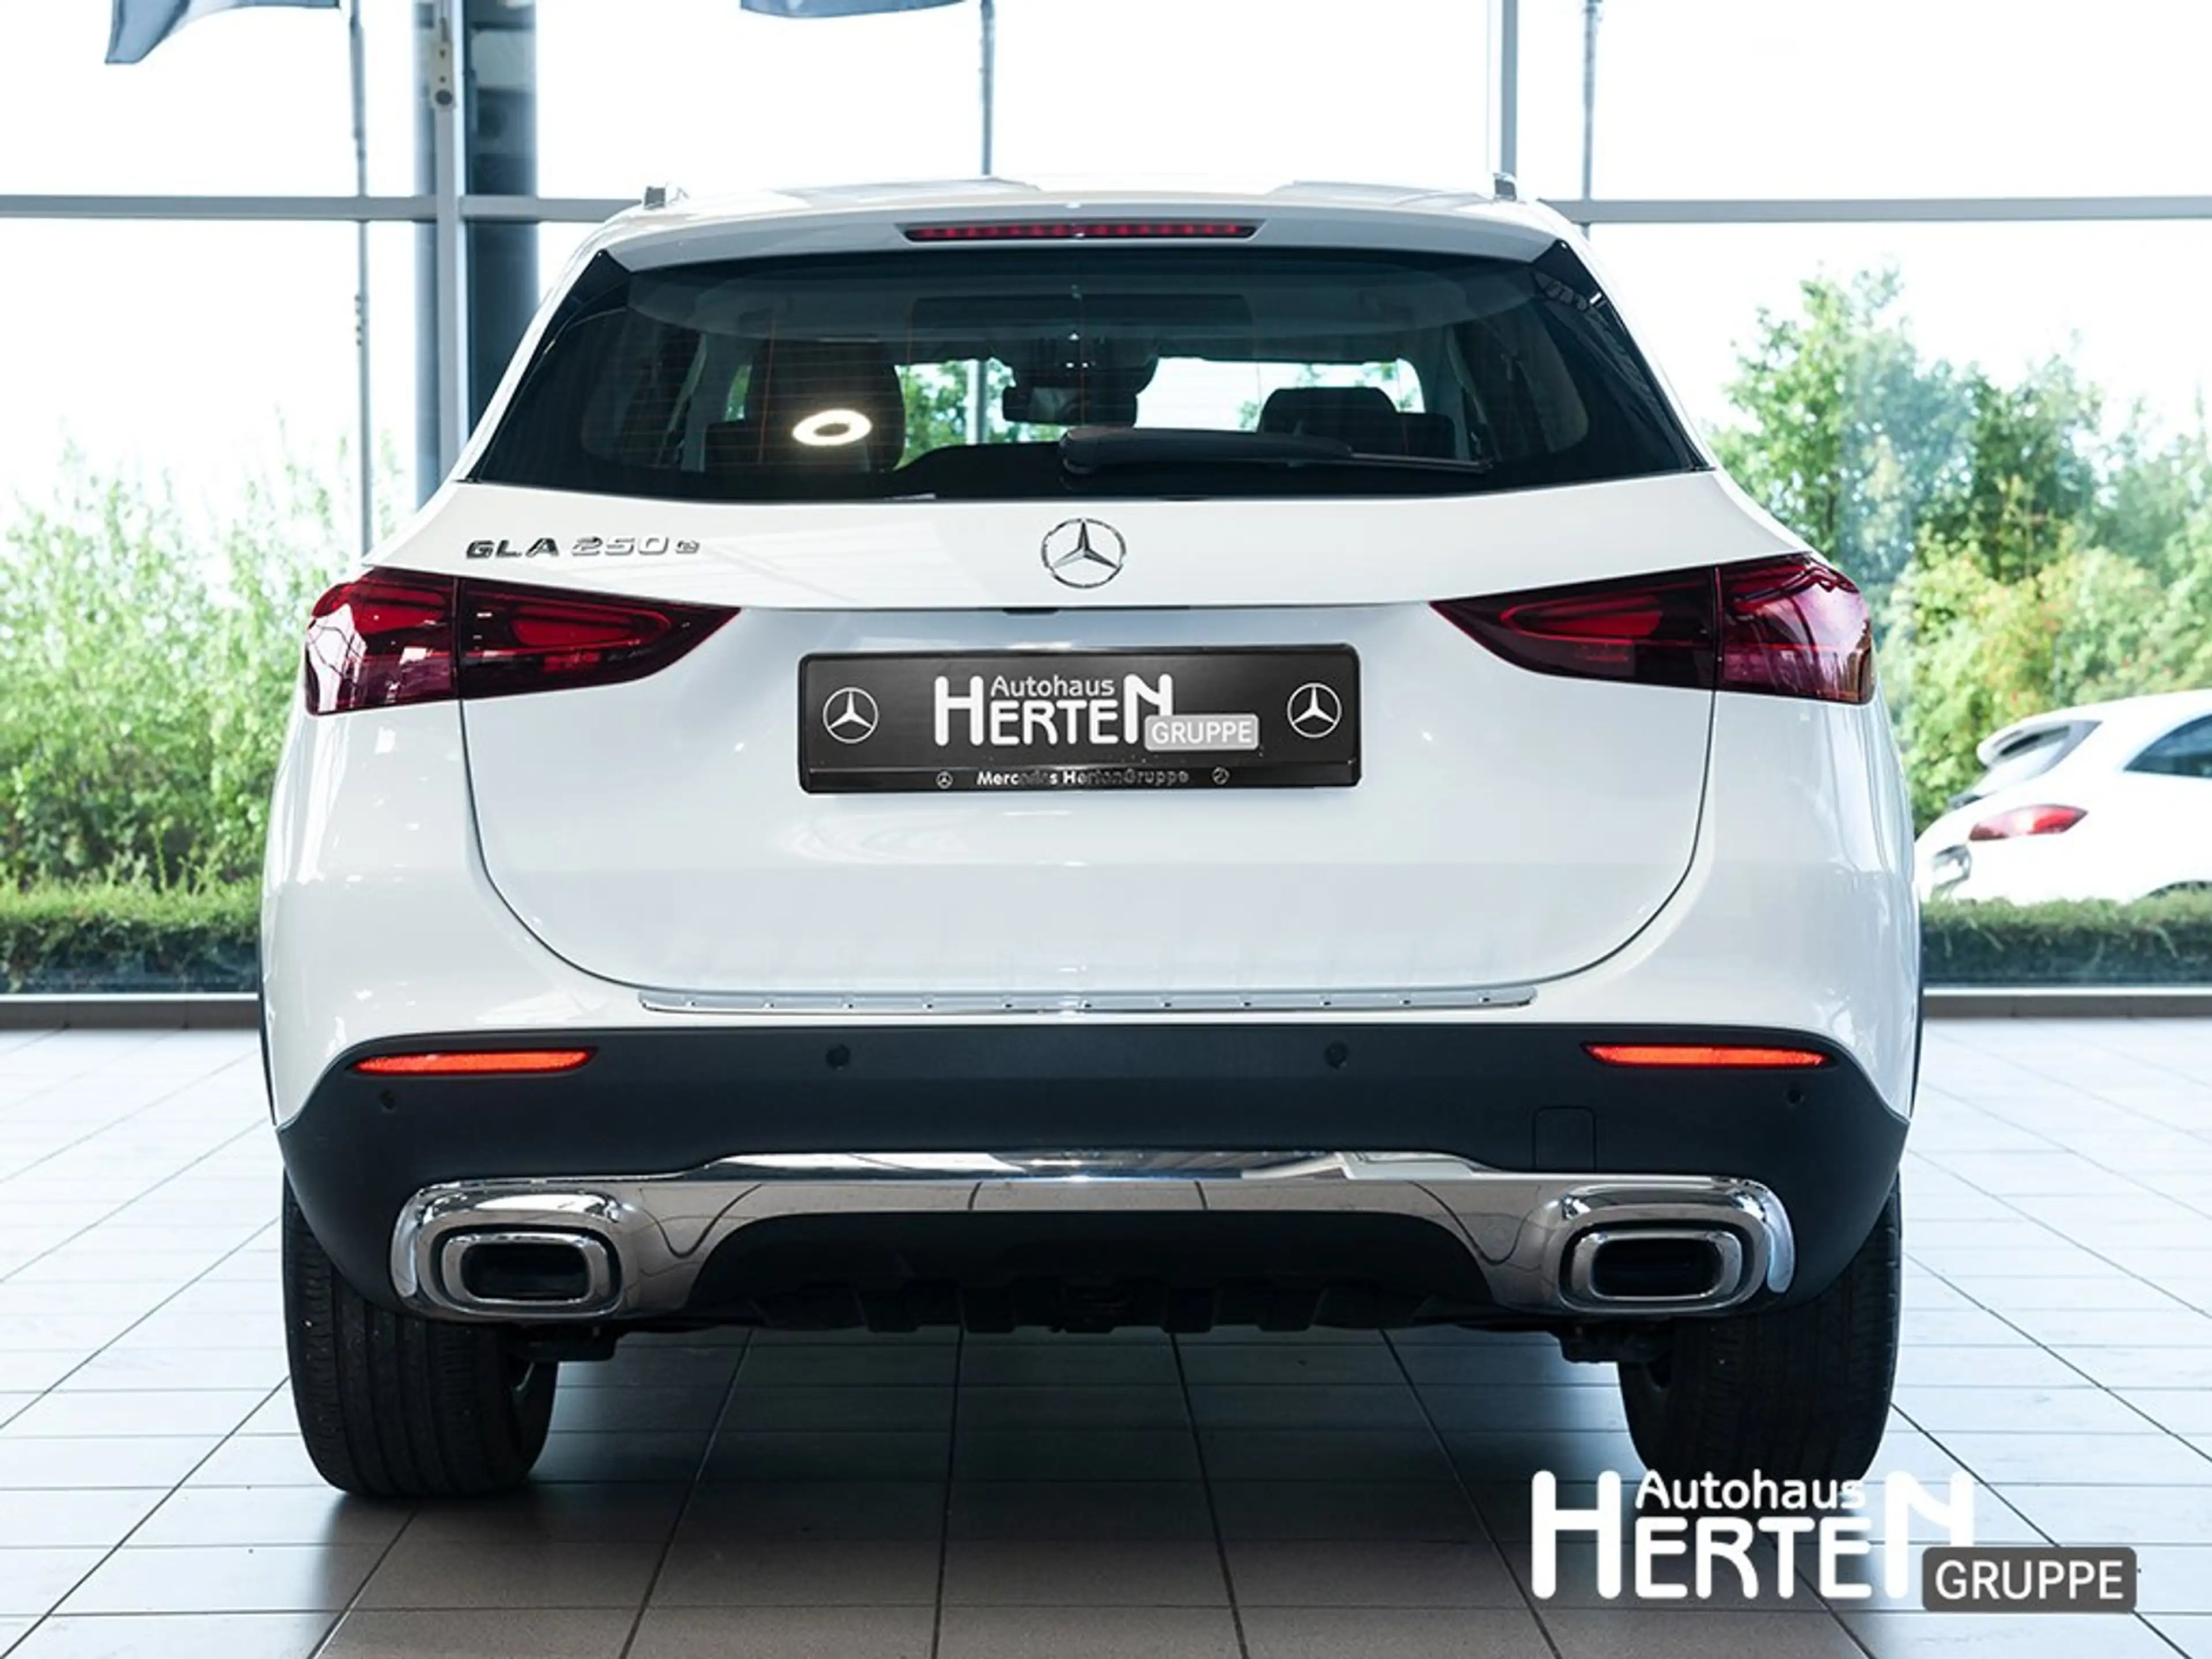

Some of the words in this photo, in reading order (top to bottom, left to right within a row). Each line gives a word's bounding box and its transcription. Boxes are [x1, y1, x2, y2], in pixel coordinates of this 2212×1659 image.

[466, 538, 560, 559] GLA
[571, 536, 669, 557] 250
[990, 675, 1115, 697] Autohaus
[934, 674, 1173, 746] HERTEN
[1152, 721, 1253, 744] GRUPPE
[976, 770, 1059, 786] Mercs
